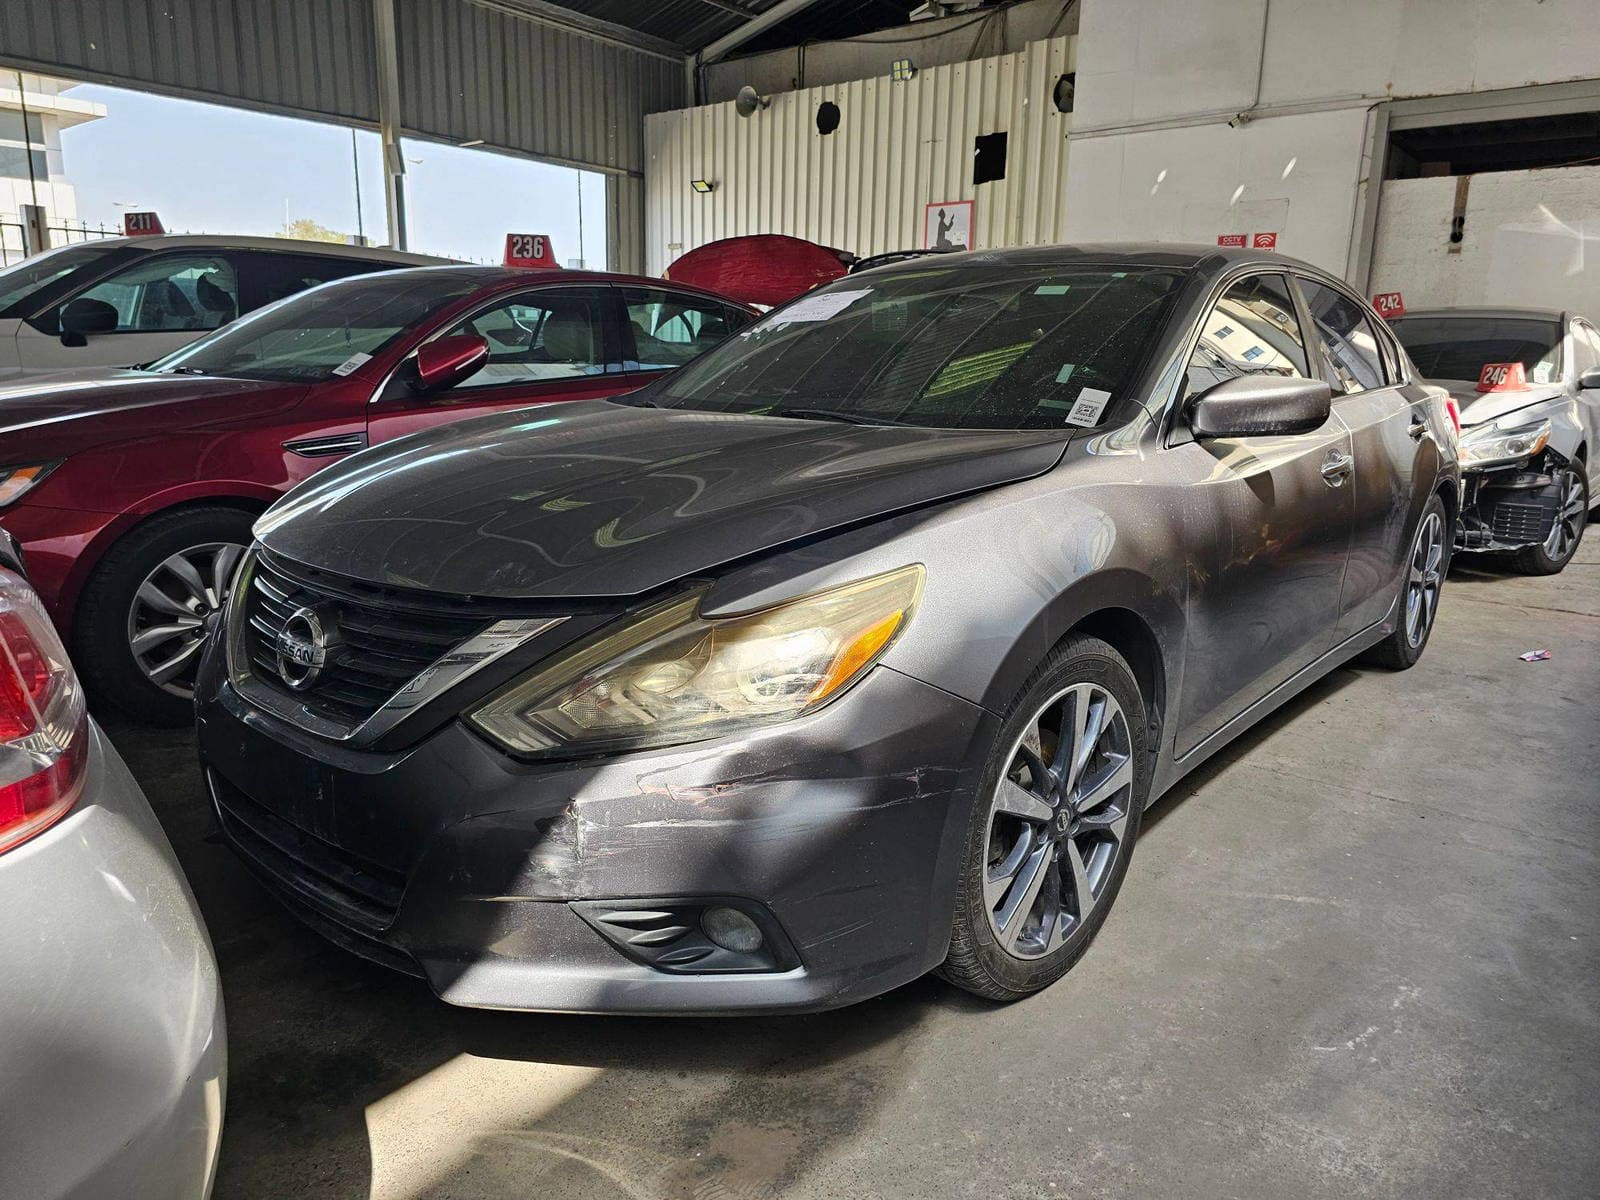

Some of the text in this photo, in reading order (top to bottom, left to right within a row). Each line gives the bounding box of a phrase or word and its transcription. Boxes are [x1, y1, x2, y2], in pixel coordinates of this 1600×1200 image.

[129, 214, 151, 230] 211
[512, 236, 544, 259] 236
[1380, 294, 1401, 311] 242
[1483, 366, 1509, 385] 246
[278, 639, 315, 663] SSAN
